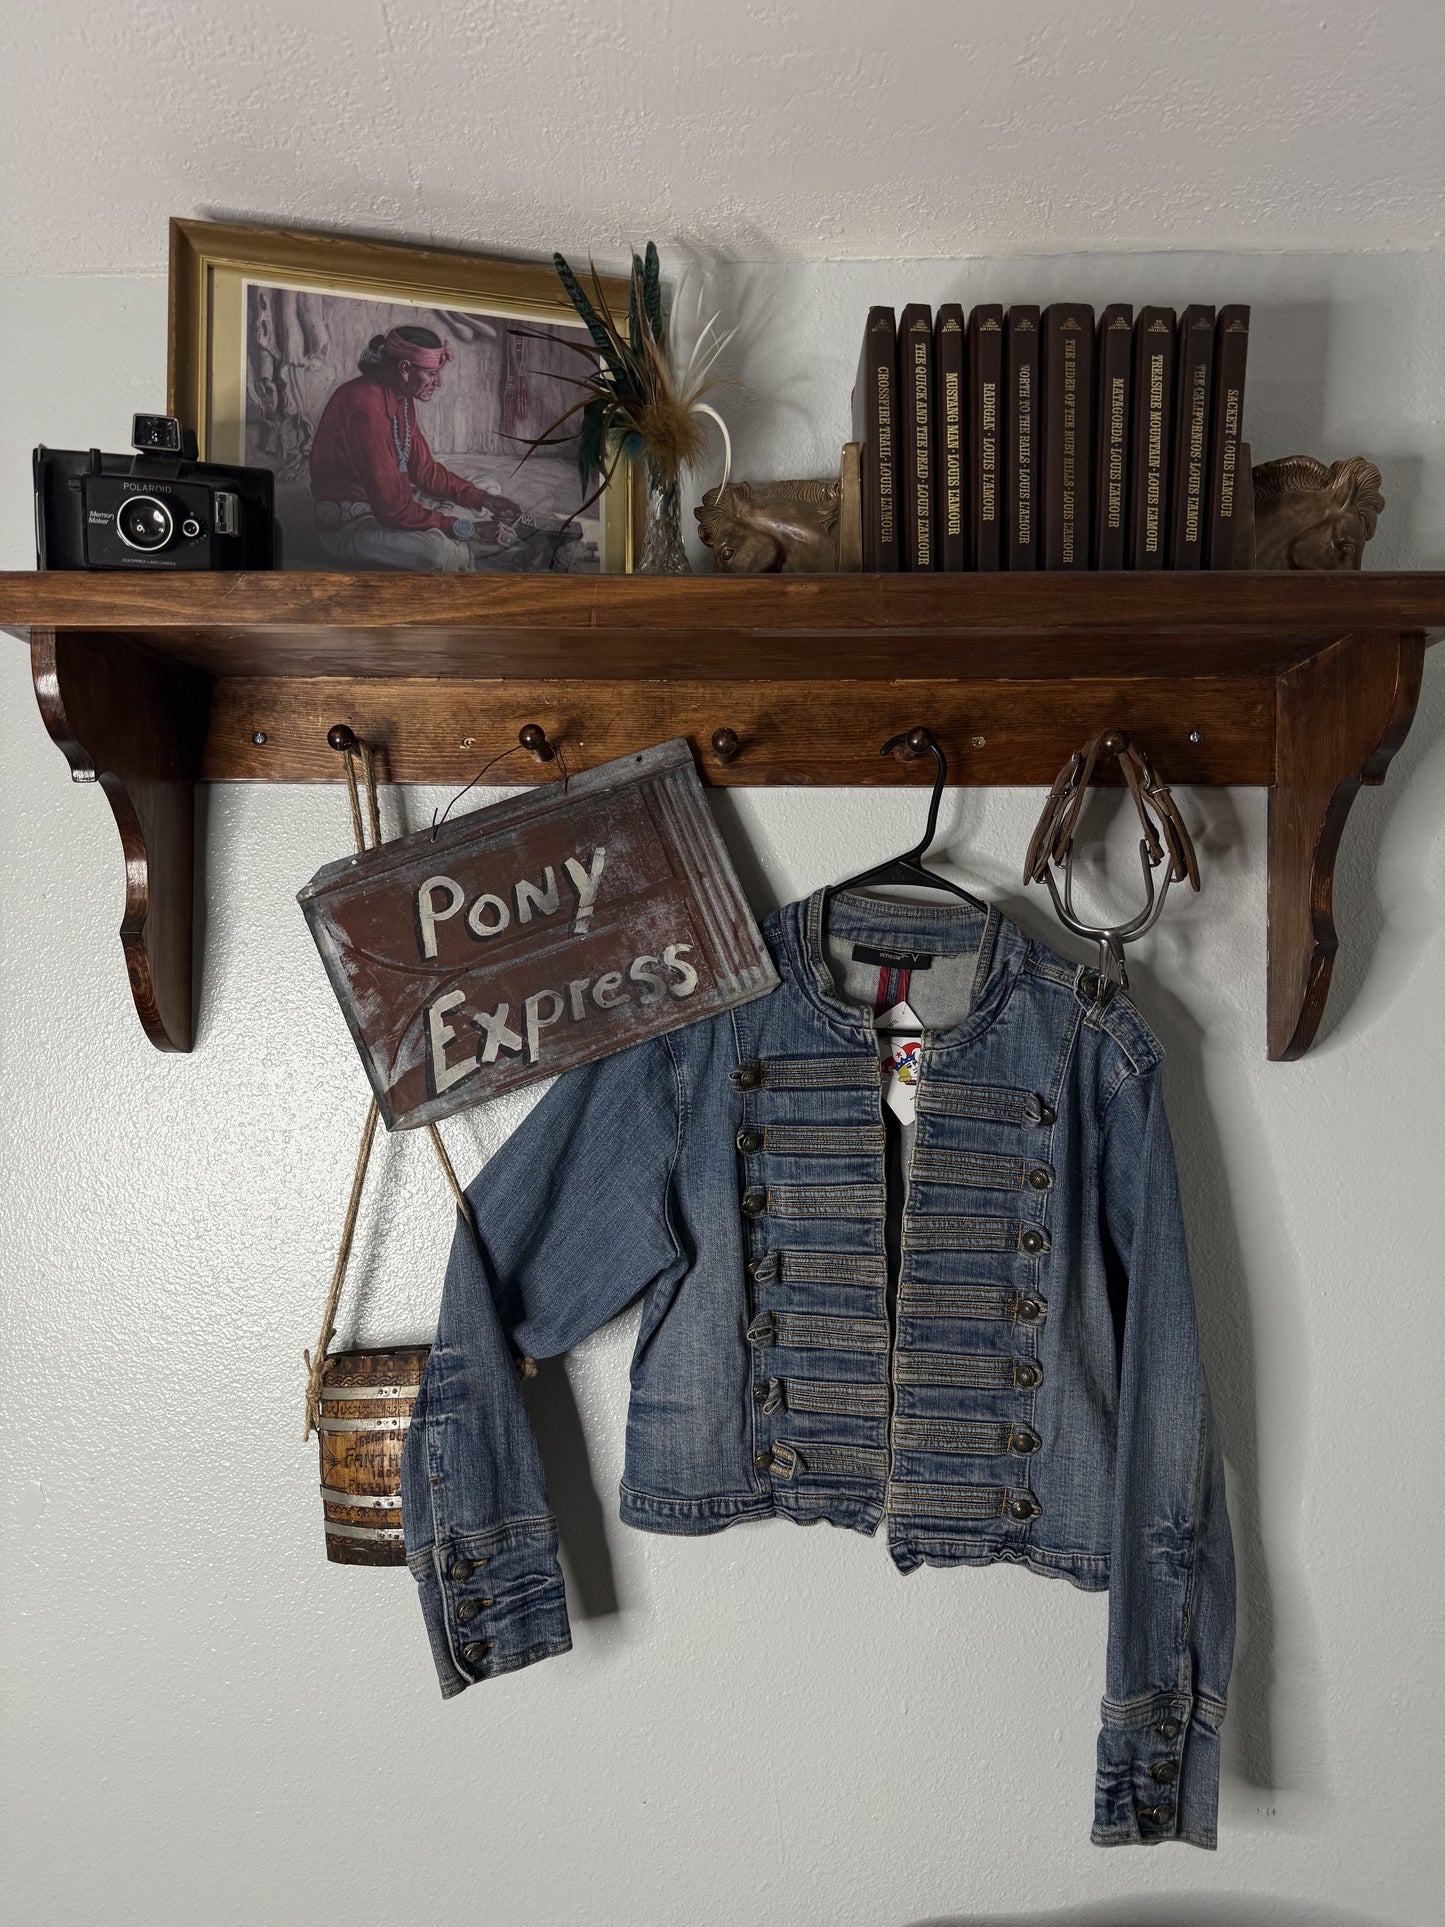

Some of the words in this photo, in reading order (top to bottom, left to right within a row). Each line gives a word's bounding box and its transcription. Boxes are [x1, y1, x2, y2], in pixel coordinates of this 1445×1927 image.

[914, 343, 927, 365] THE
[1065, 338, 1076, 358] THE
[915, 366, 927, 400] QUICK
[1019, 364, 1031, 397] NORTH
[1064, 360, 1076, 391] RIDER
[1150, 354, 1163, 408] TREASURE
[1194, 364, 1206, 385] THE
[877, 366, 890, 424] CROSSFIRE
[945, 372, 959, 422] MUSTANG
[983, 383, 996, 430] RADIGAN
[1019, 399, 1030, 413] TO
[1064, 393, 1075, 408] OF
[1111, 378, 1124, 444] MATAGORDA
[915, 401, 928, 424] AND
[1019, 414, 1030, 434] THE
[1064, 408, 1075, 428] THE
[1191, 387, 1205, 458] CALIFORNIOS
[1225, 389, 1239, 435] SACKETT
[878, 426, 891, 459] TRAIL
[916, 426, 928, 447] THE
[946, 425, 959, 449] MAN
[1018, 435, 1030, 464] RAILS
[1064, 430, 1075, 457] RUBY
[1148, 410, 1161, 467] MOUNTAIN
[916, 449, 928, 479] DEAD
[947, 454, 960, 486] LOUIS
[982, 437, 995, 471] LOUIS
[1110, 447, 1122, 479] LOUIS
[1223, 440, 1237, 471] LOUIS
[123, 482, 172, 494] POLAROID
[879, 462, 892, 494] LOUIS
[1018, 468, 1030, 499] LOUIS
[1063, 457, 1075, 487] HILLS
[1148, 472, 1159, 504] LOUIS
[1187, 462, 1202, 494] LOUIS
[917, 484, 929, 516] LOUIS
[982, 473, 995, 521] L'AMOUR
[1063, 490, 1074, 520] LOUIS
[1108, 482, 1121, 528] L'AMOUR
[1220, 473, 1234, 517] L'AMOUR
[880, 497, 893, 543] L'AMOUR
[947, 489, 960, 535] L'AMOUR
[1018, 501, 1030, 544] L'AMOUR
[1185, 496, 1200, 542] L'AMOUR
[917, 518, 929, 565] L'AMOUR
[1062, 522, 1074, 563] L'AMOUR
[1146, 506, 1158, 552] L'AMOUR
[424, 943, 698, 1096] Express
